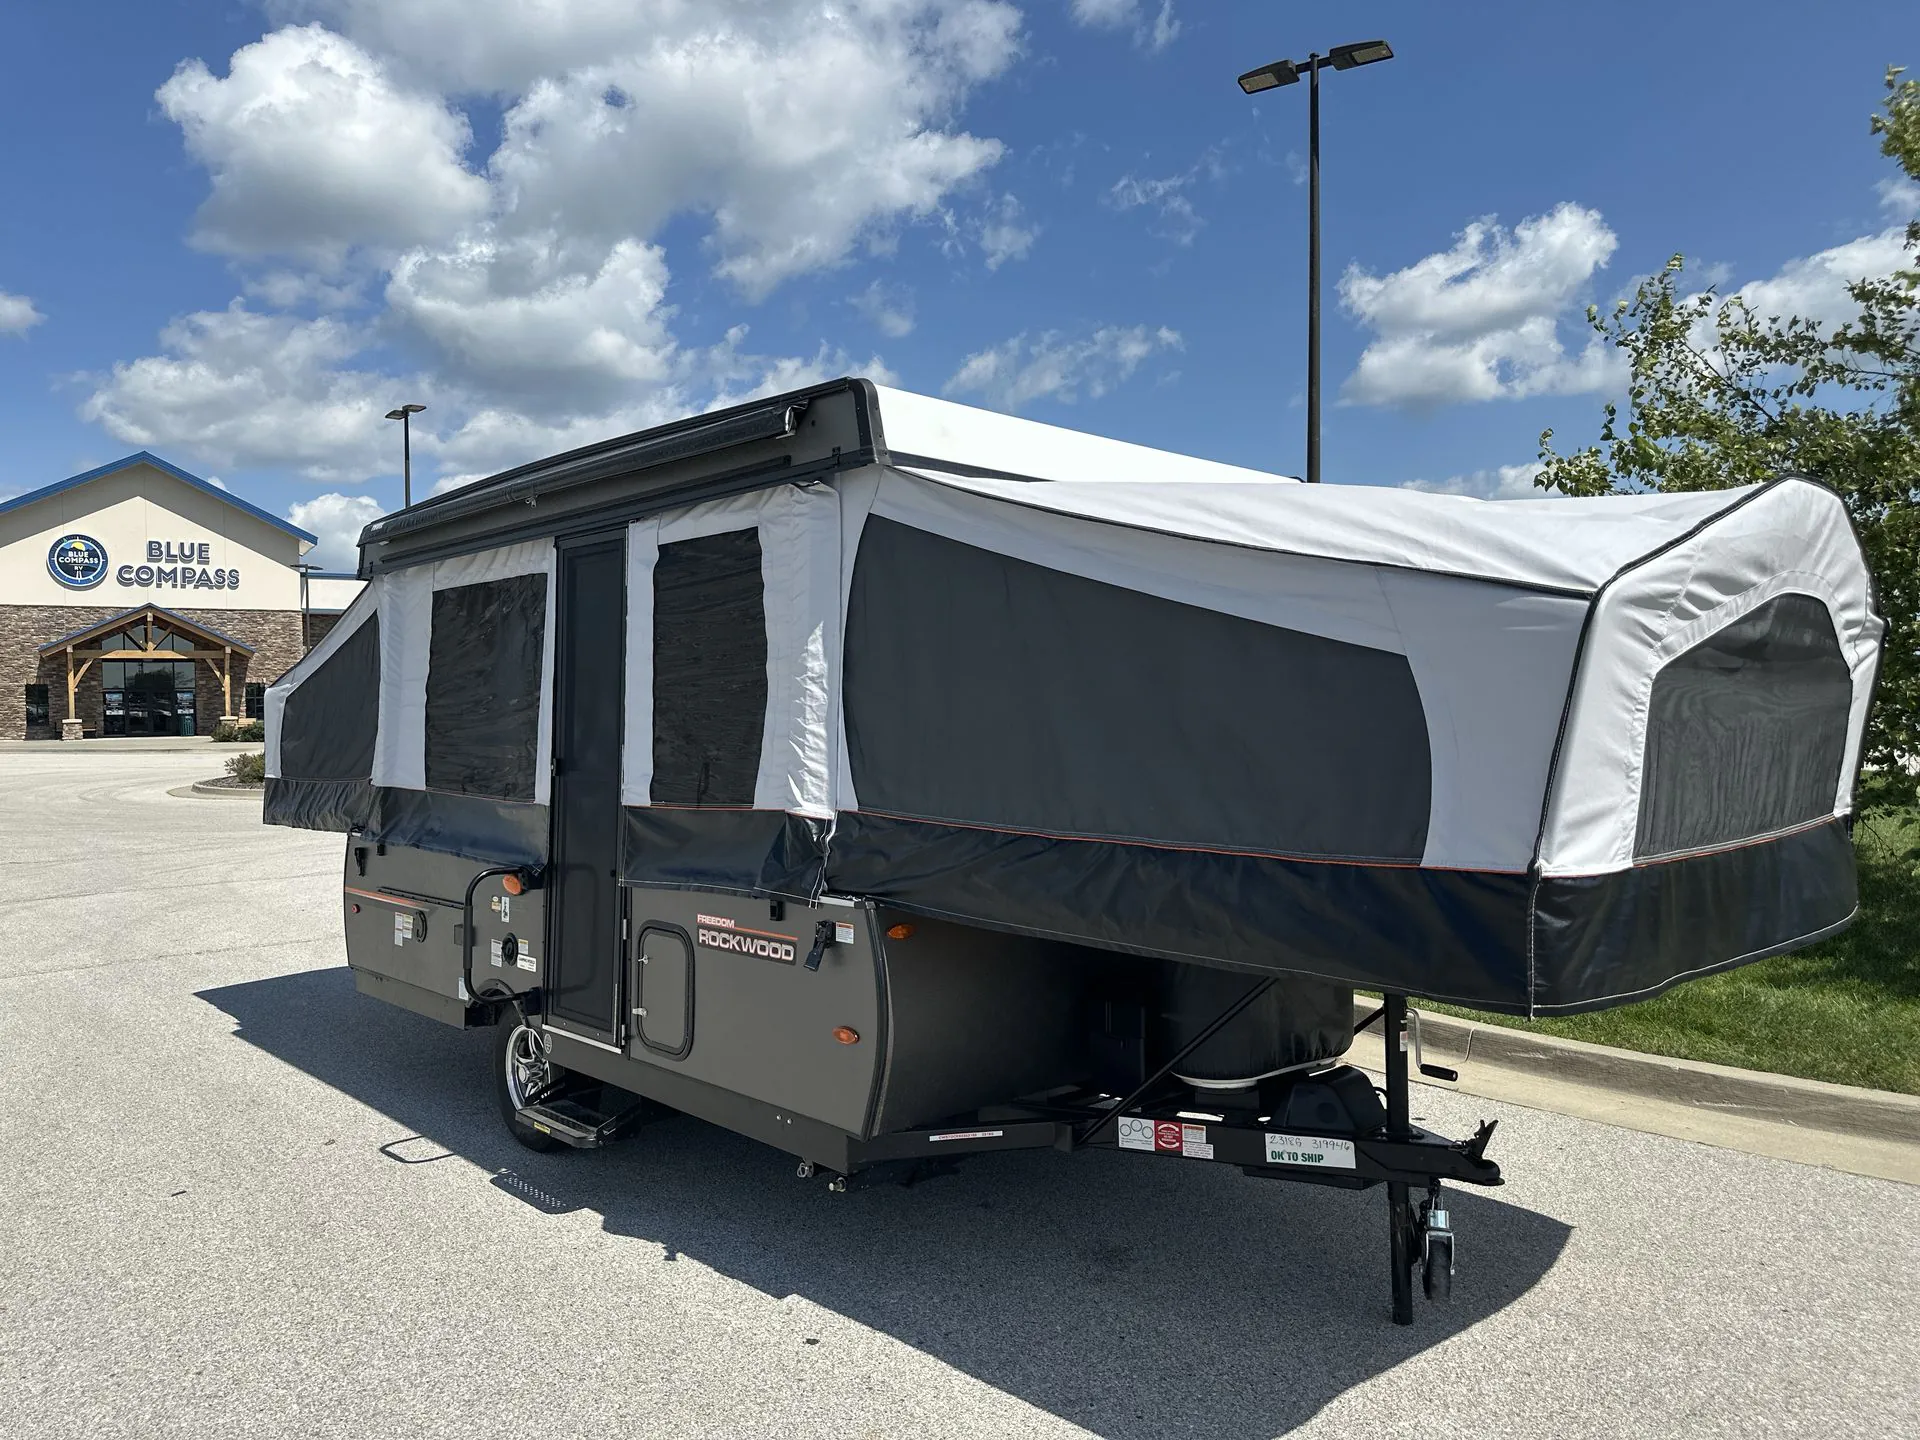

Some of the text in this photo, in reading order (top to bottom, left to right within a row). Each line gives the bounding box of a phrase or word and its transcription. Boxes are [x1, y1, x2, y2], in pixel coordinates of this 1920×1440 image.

[58, 556, 99, 564] COMPASS
[148, 540, 210, 563] BLUE
[117, 564, 240, 588] COMPASS
[697, 914, 735, 928] FREEDOM
[698, 928, 795, 961] ROCKWOOD
[1271, 1150, 1324, 1163] OK TO SHIP
